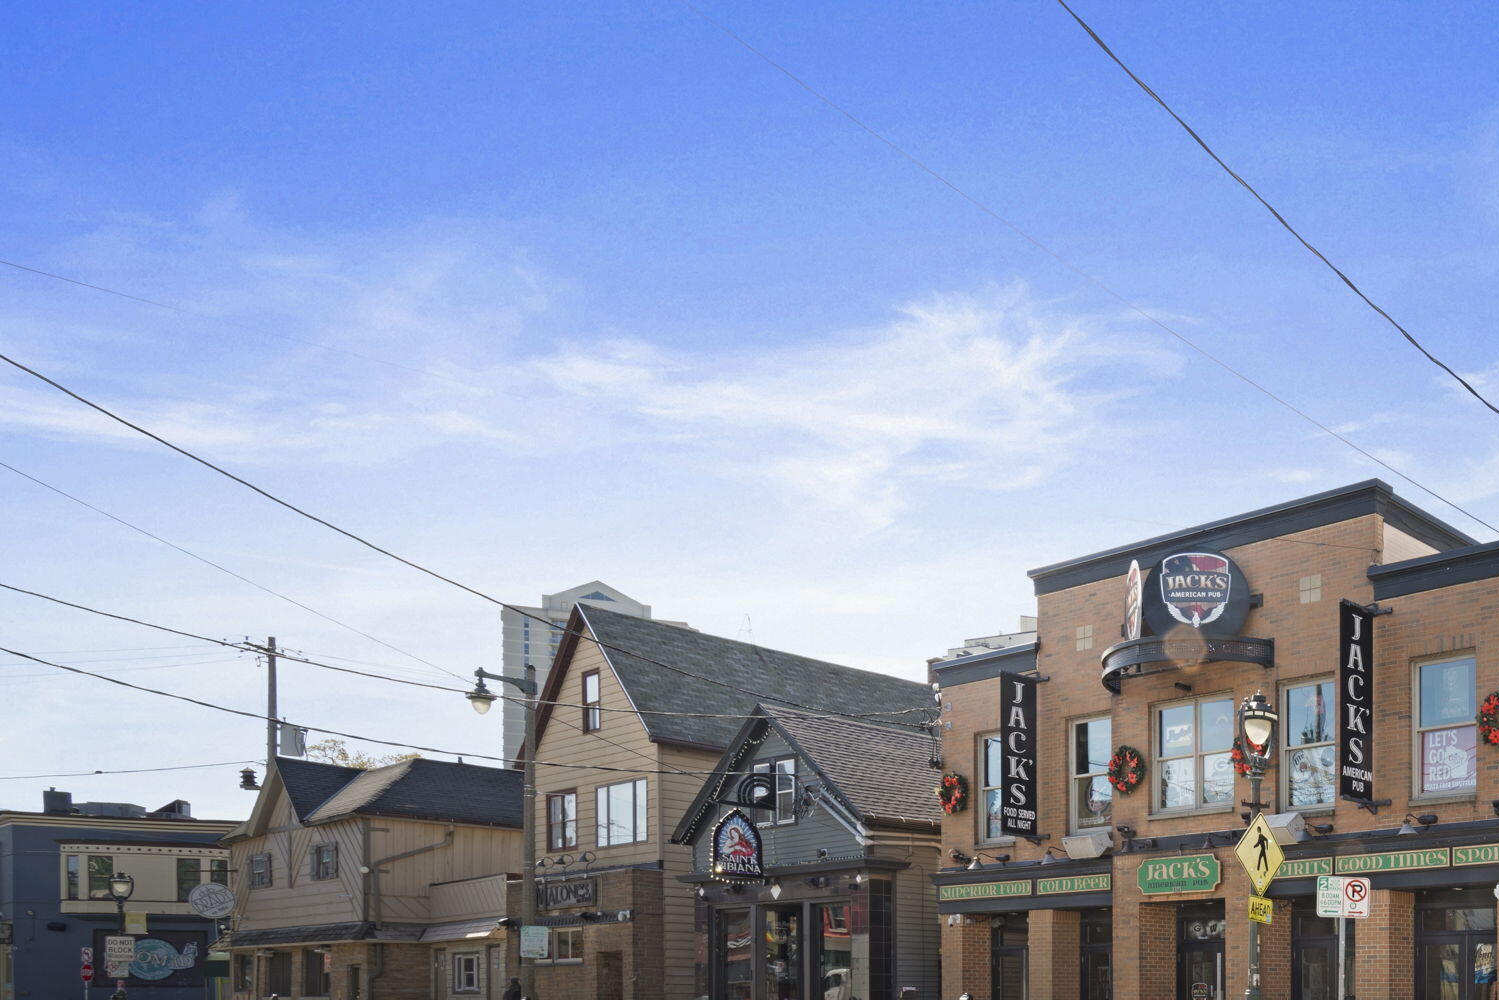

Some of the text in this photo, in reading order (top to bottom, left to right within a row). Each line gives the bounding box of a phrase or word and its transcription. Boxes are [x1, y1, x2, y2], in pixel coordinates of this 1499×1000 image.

[1166, 574, 1227, 590] JACK'S
[1346, 613, 1370, 764] JACK'S
[1007, 681, 1033, 806] JACK'S
[1429, 730, 1458, 748] LET'S
[1429, 748, 1445, 764] GO
[1342, 765, 1372, 782] AMERICAN
[1429, 766, 1451, 781] RED
[1352, 780, 1364, 793] PUB
[1003, 806, 1035, 821] FOOD SERVED
[1007, 817, 1031, 830] ALL NIGHT
[722, 854, 757, 864] SAINT
[1338, 855, 1382, 872] GOOD
[1276, 860, 1330, 876] PIRITS
[1000, 881, 1031, 895] FOOD
[1039, 879, 1071, 892] COLD
[1250, 901, 1271, 917] AHEAD
[108, 946, 133, 954] BLOCK
